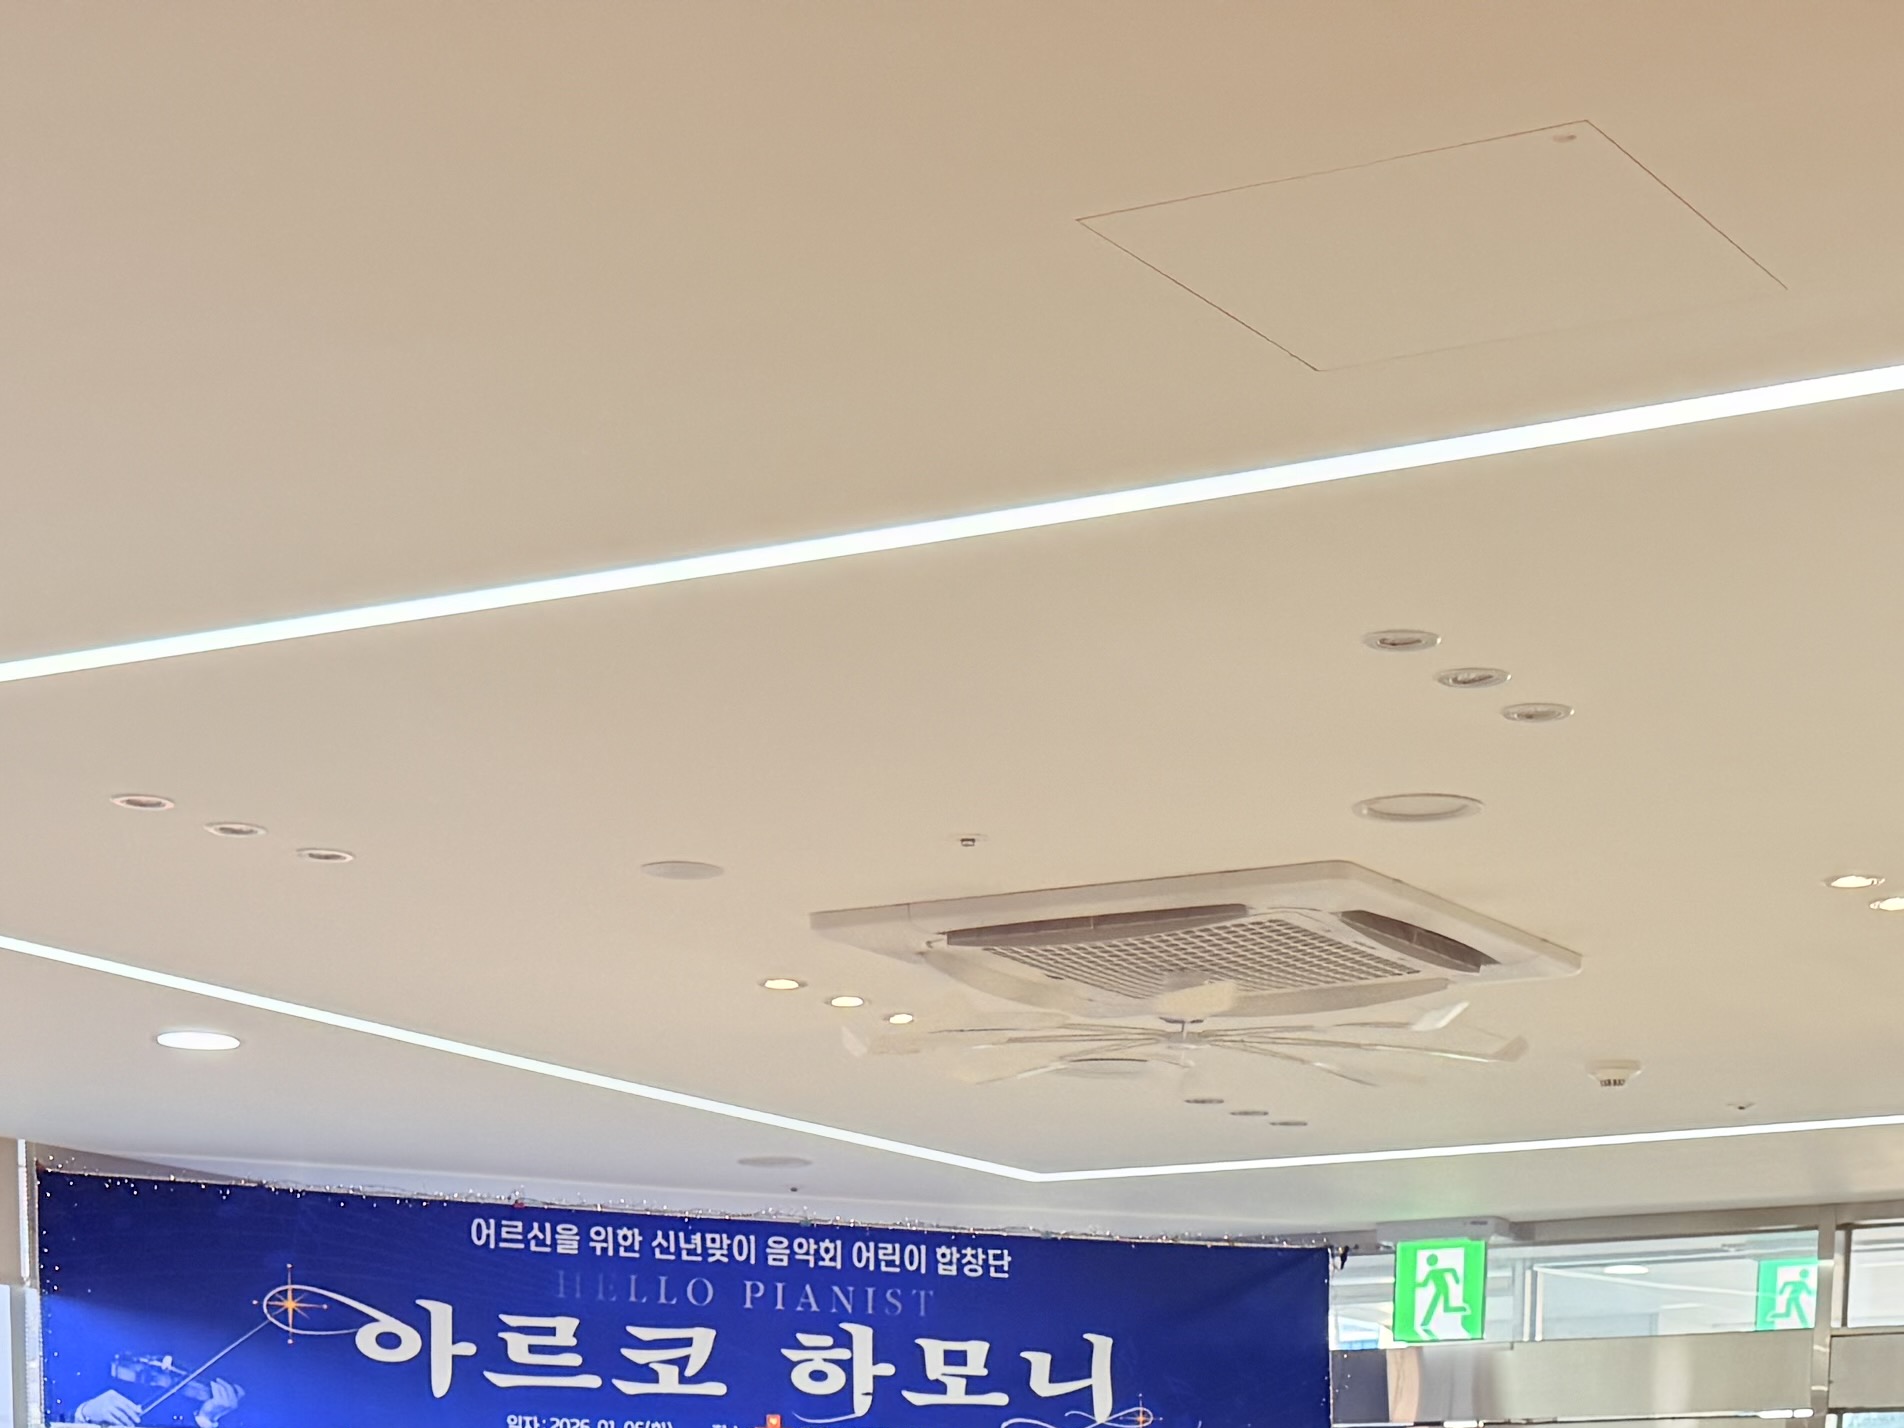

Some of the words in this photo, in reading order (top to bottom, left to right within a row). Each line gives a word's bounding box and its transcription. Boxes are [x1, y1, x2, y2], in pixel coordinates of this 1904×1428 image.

[470, 1217, 581, 1254] 어르신을
[589, 1226, 643, 1258] 위한
[651, 1230, 757, 1265] 신년맞이
[765, 1235, 844, 1271] 음악회
[852, 1239, 927, 1275] 어린이
[935, 1245, 1012, 1279] 합창단
[557, 1269, 715, 1307] HELLO
[744, 1279, 936, 1318] PIANIST
[355, 1297, 729, 1399] 아르코
[781, 1321, 1115, 1424] 하모니
